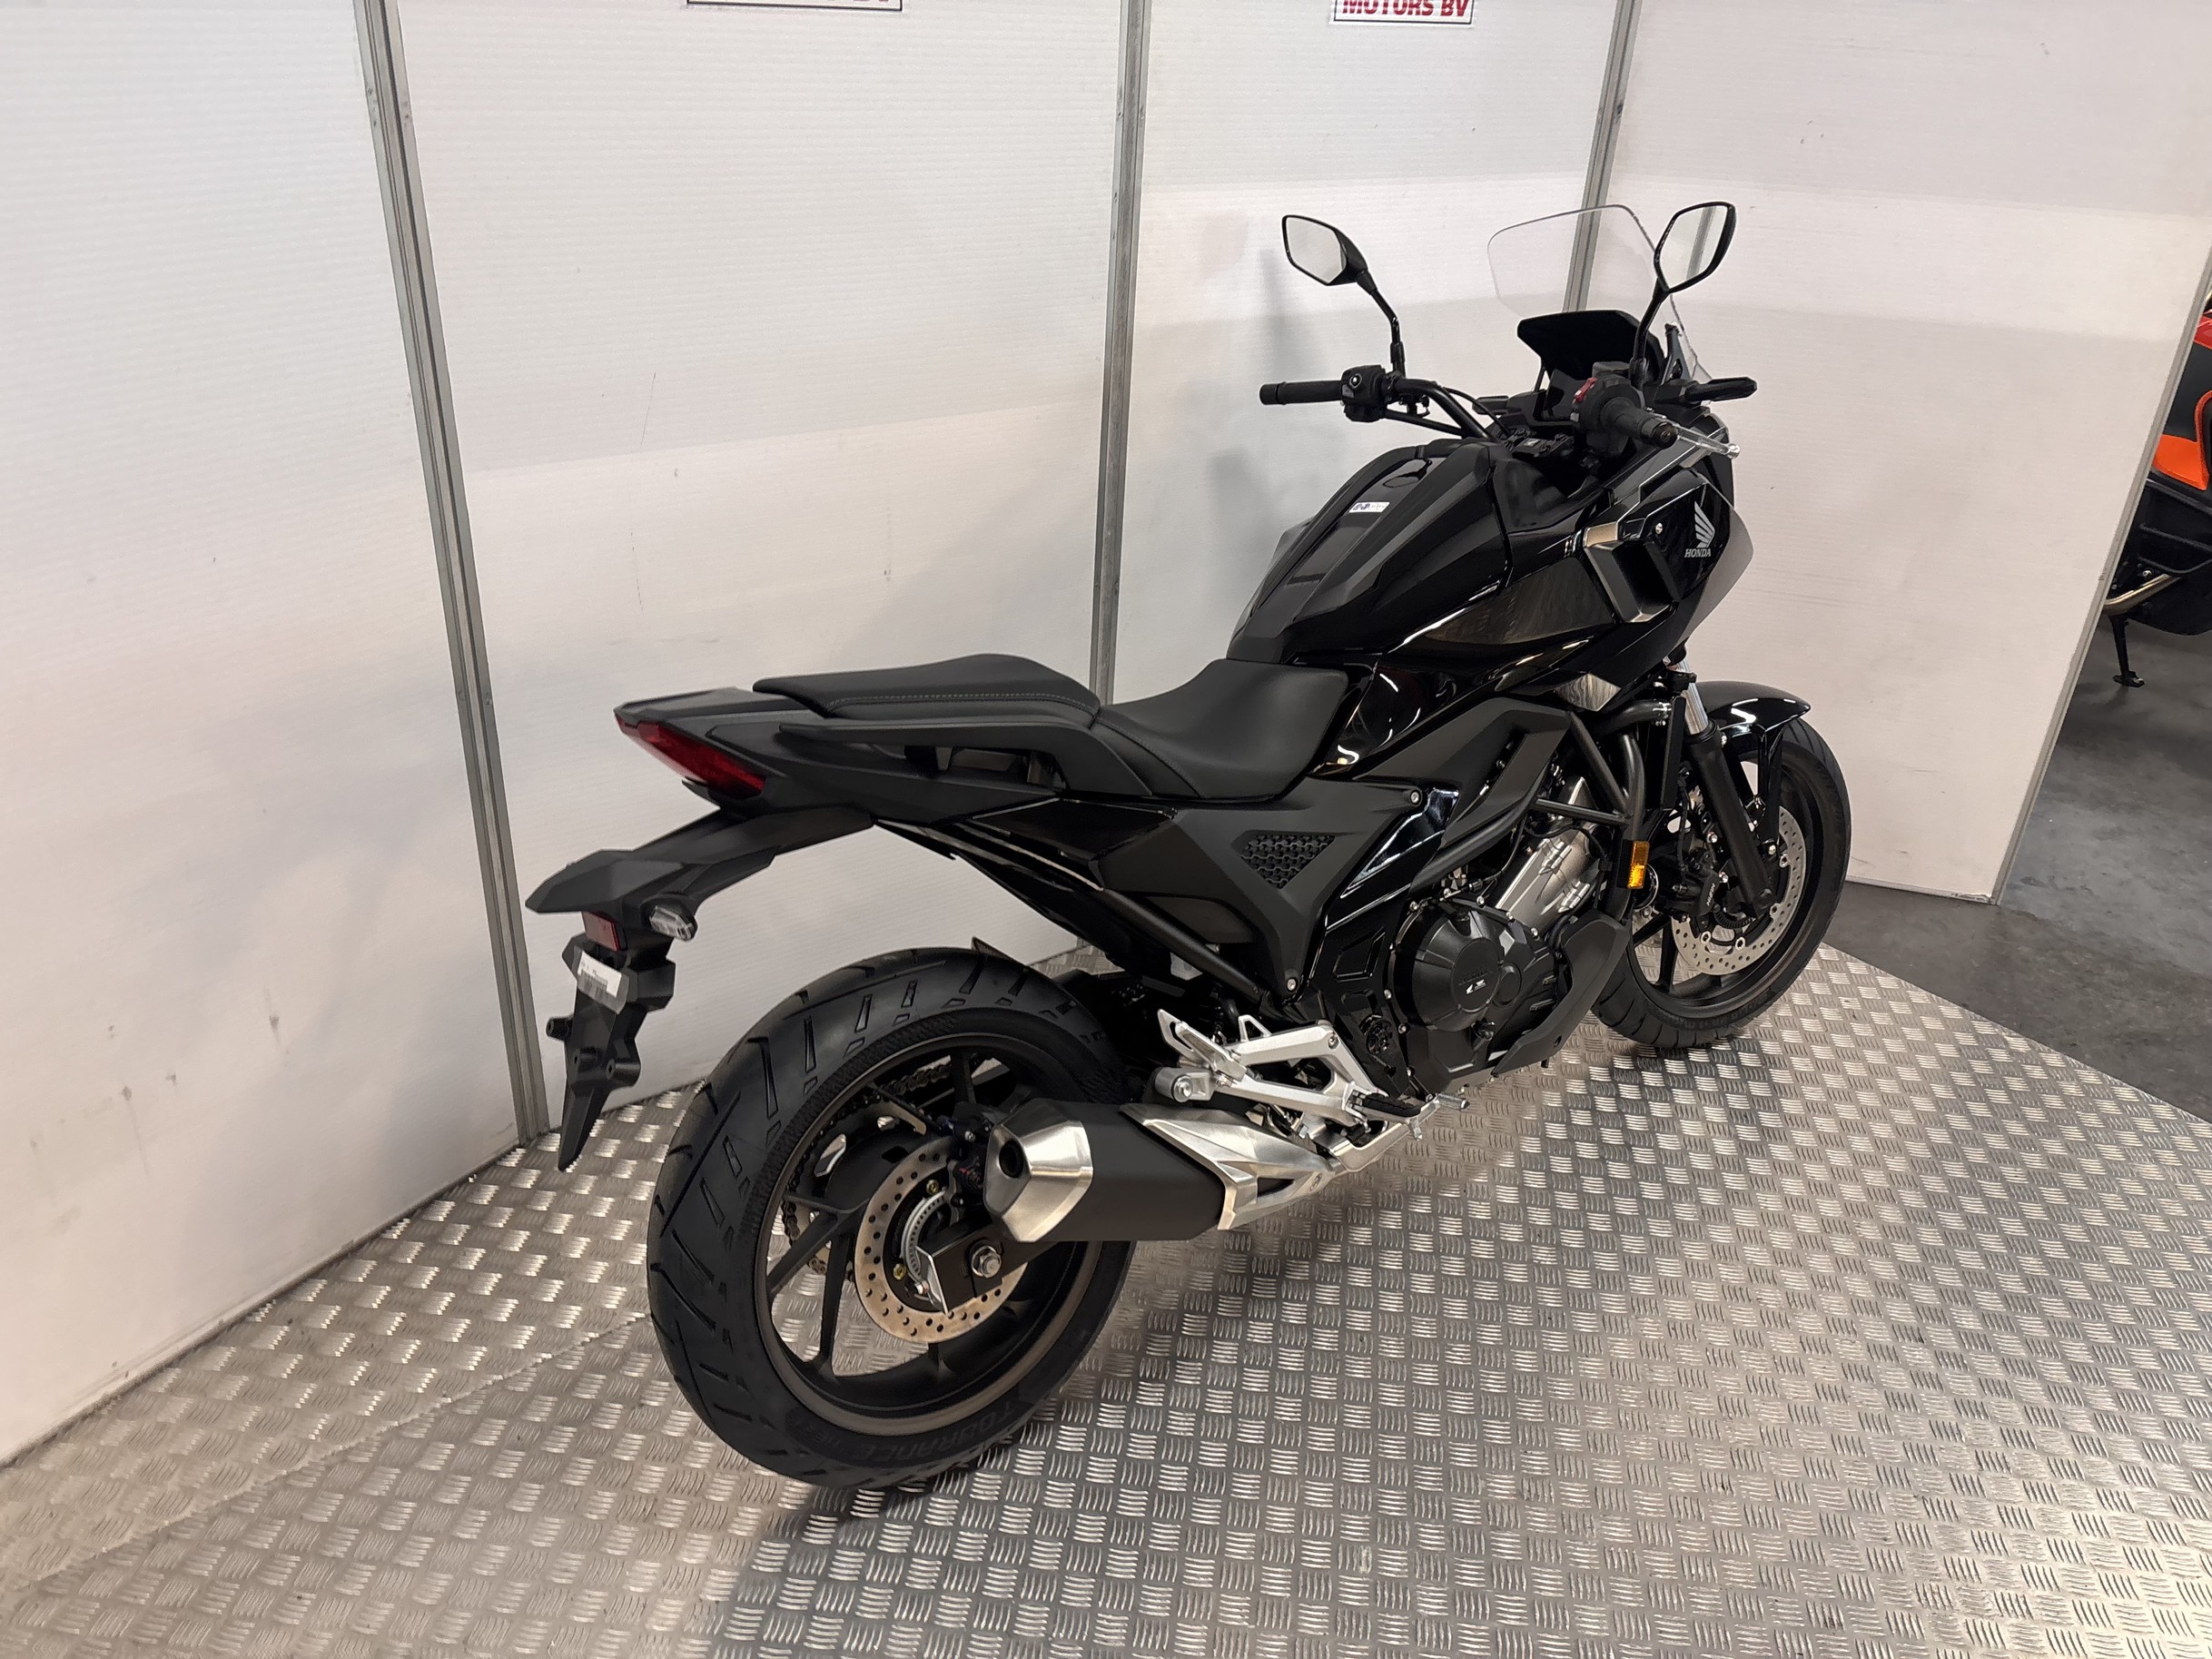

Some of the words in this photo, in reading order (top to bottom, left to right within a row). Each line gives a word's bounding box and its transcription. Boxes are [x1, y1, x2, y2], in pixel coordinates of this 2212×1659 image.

[1342, 0, 1434, 15] MOTORS
[1440, 0, 1469, 16] BV
[1684, 548, 1712, 558] HONDA
